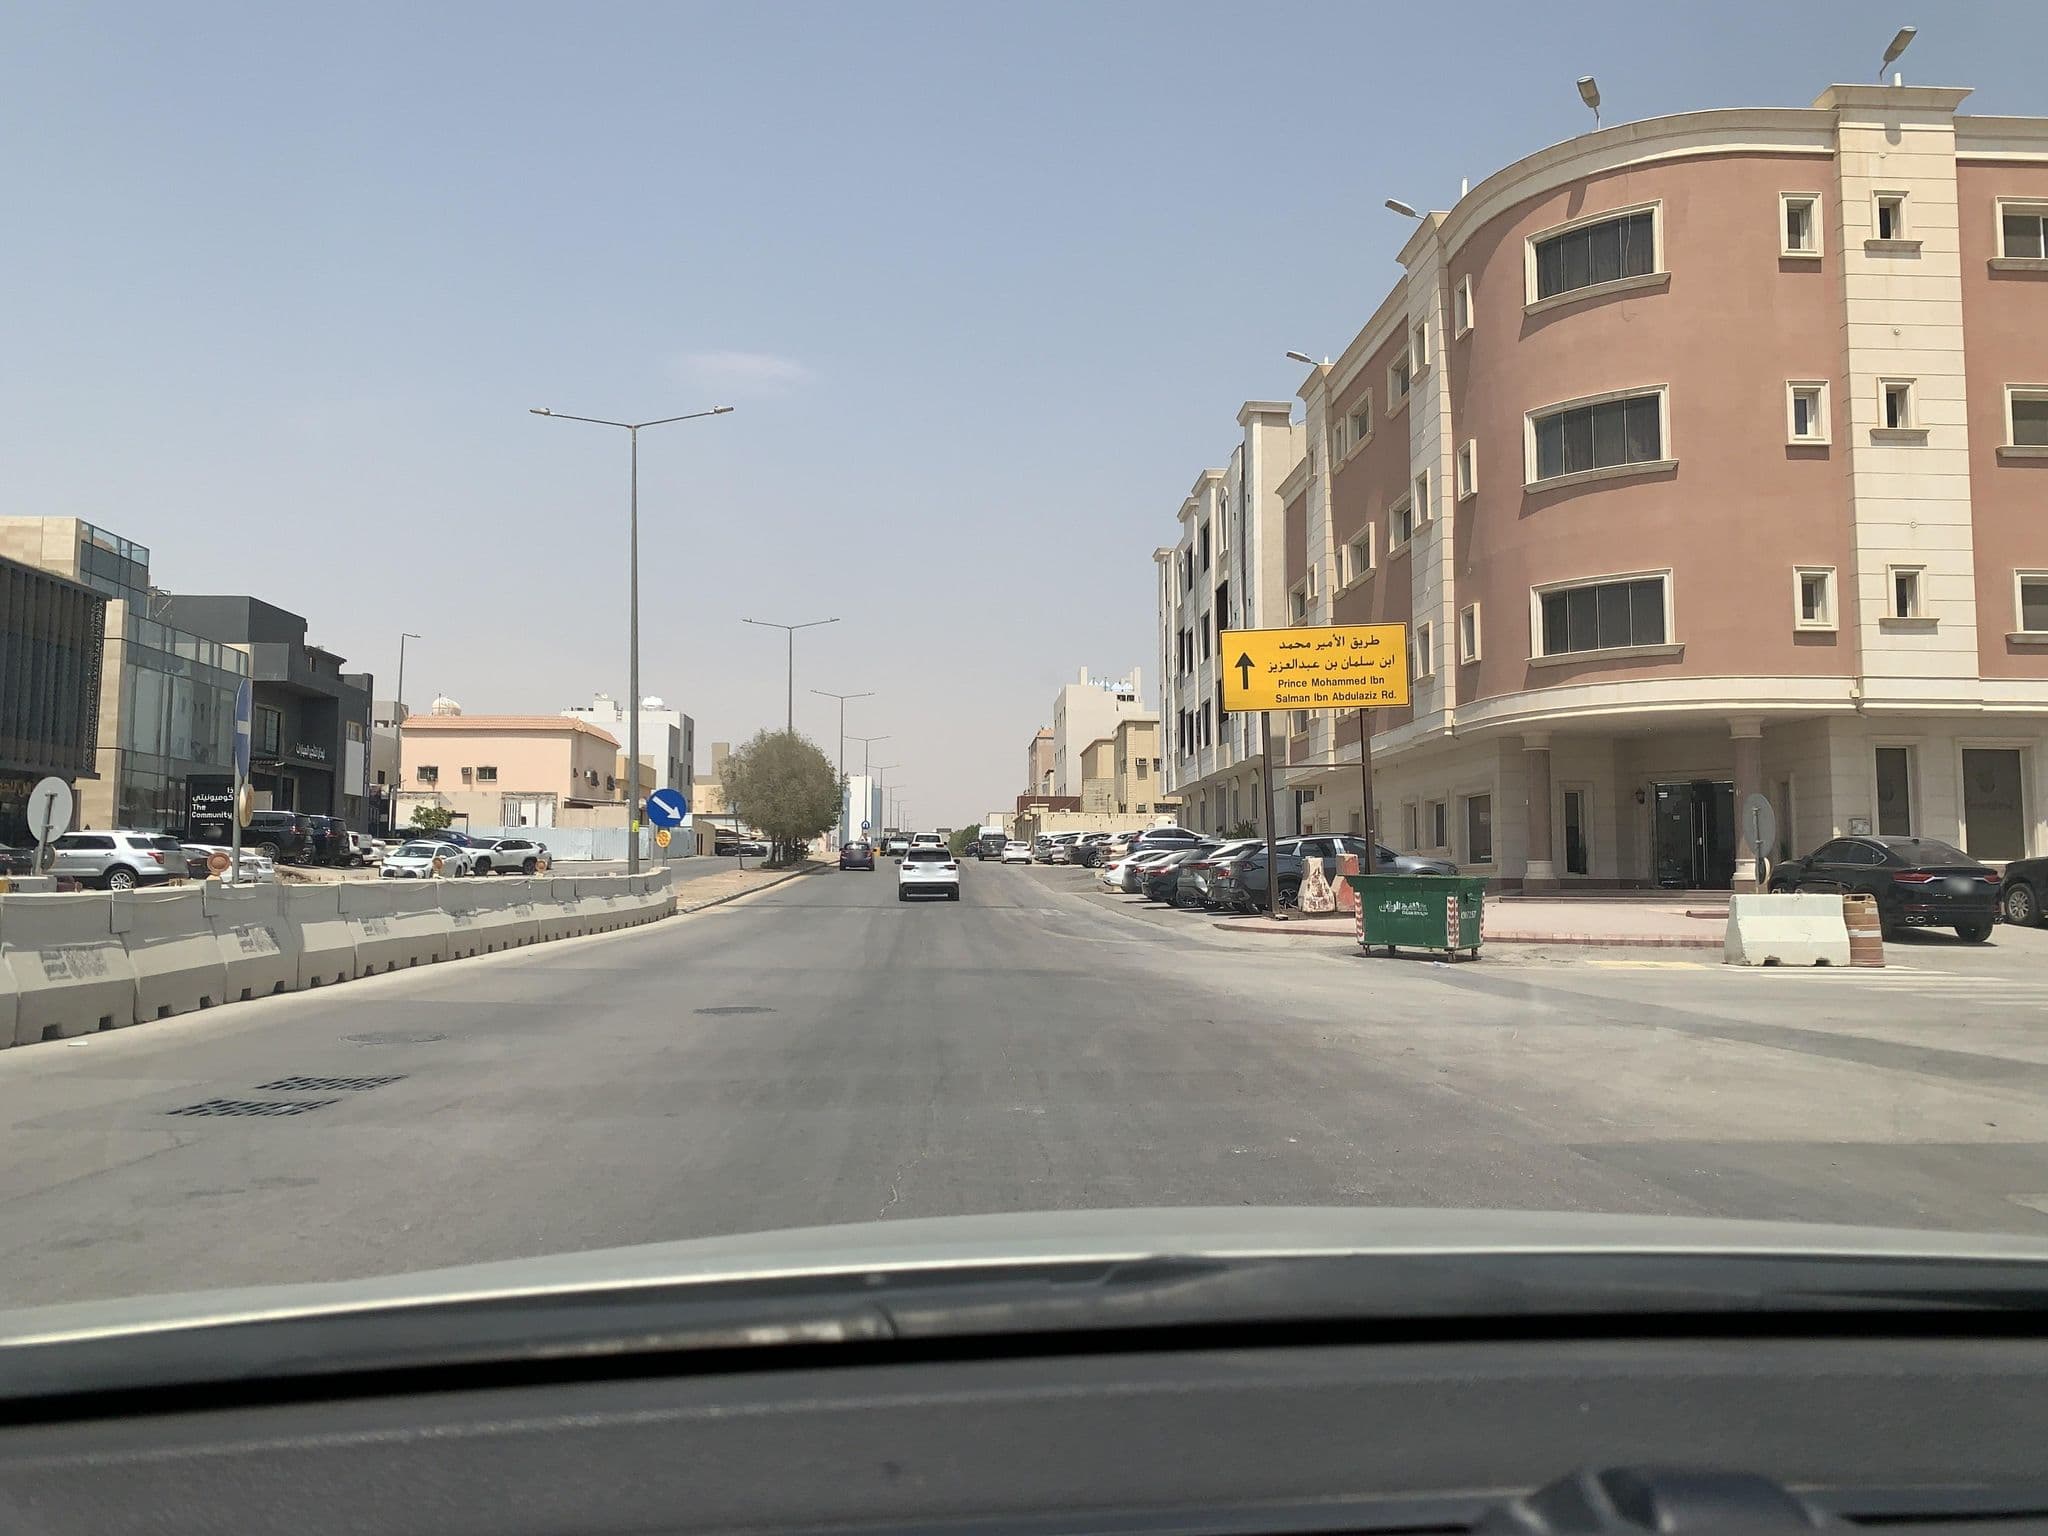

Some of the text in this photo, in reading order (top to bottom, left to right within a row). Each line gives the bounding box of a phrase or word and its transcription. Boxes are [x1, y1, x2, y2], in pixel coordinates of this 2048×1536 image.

[1279, 634, 1380, 651] طريق الأمير محمد
[1267, 654, 1395, 673] ابن سلمان بن عبدالعزيز
[1278, 676, 1385, 688] Prince Mohammed Ibn
[1275, 690, 1397, 703] Salman Ibn Abdulaziz Rd.
[192, 803, 206, 811] The
[191, 811, 233, 820] Community
